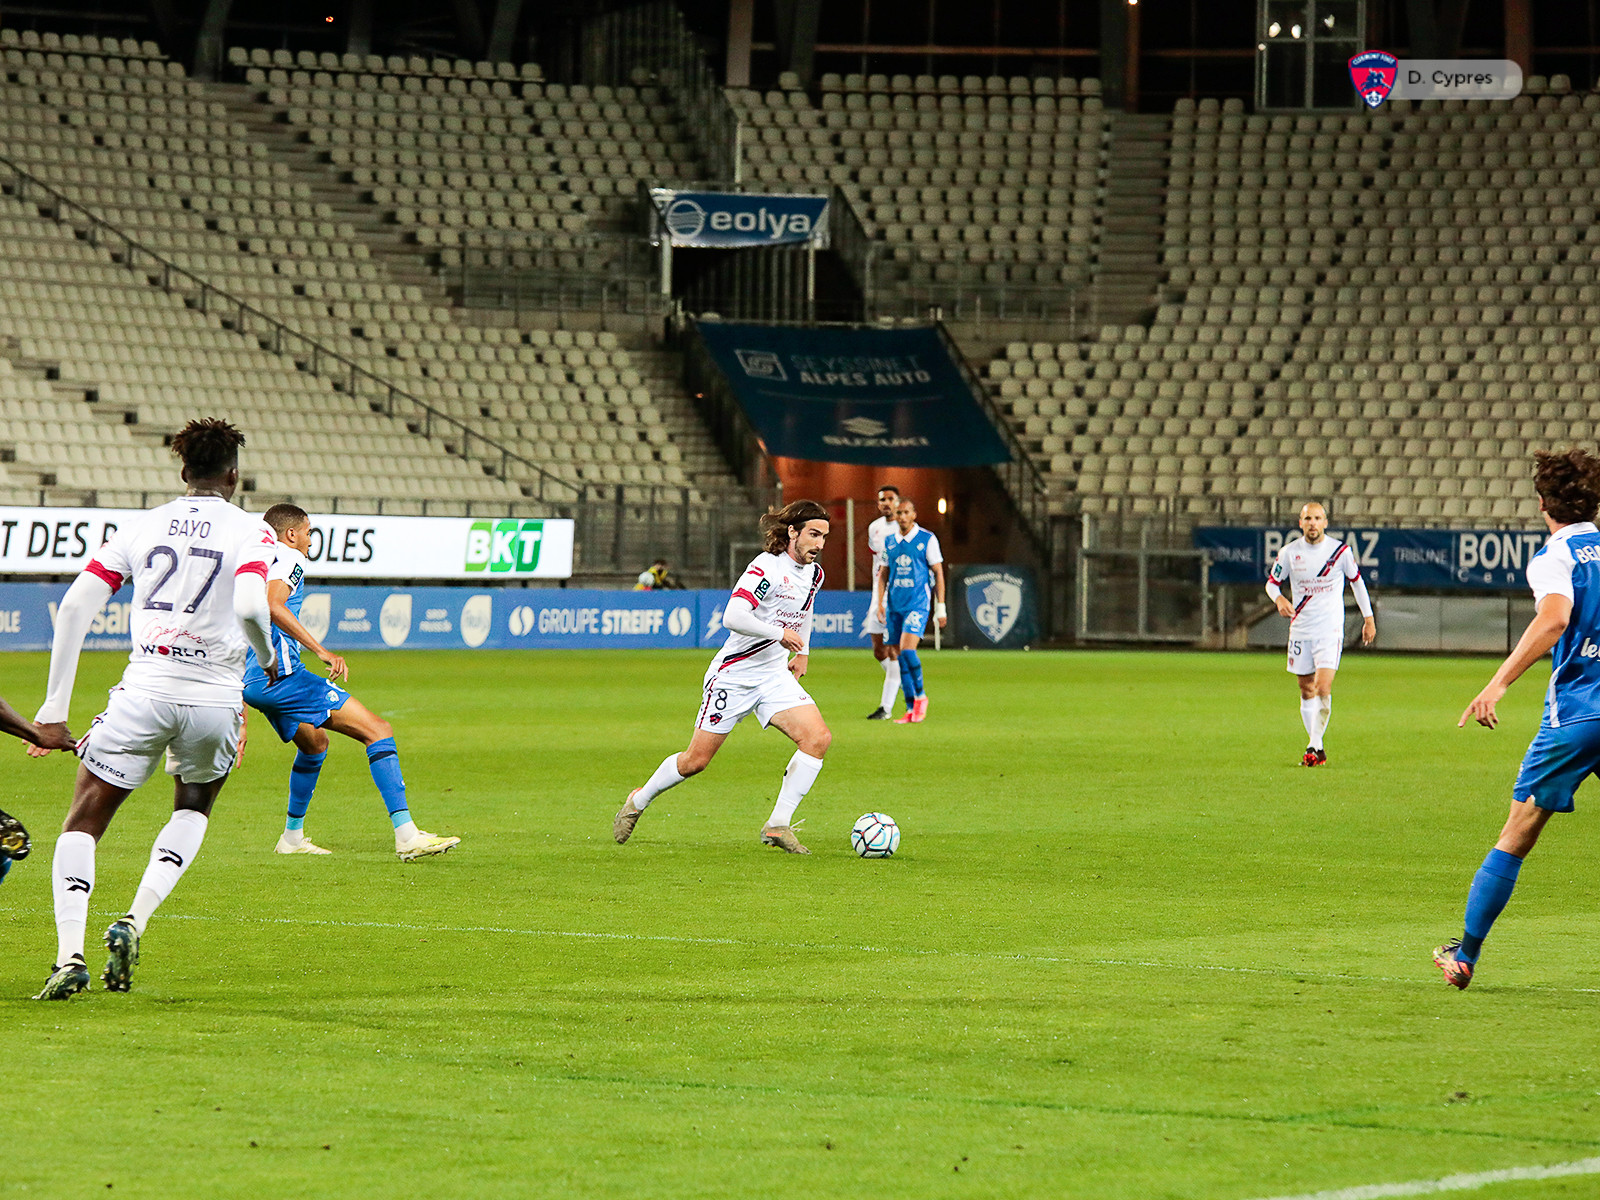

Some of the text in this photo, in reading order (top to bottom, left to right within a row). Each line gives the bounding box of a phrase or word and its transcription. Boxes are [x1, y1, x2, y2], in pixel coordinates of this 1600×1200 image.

[874, 369, 931, 386] AUTO
[168, 519, 211, 539] BAYO
[27, 521, 90, 558] DES
[308, 527, 375, 563] OLES
[465, 525, 543, 568] BKT
[1459, 533, 1549, 570] BONT
[143, 545, 223, 613] 27
[538, 607, 665, 636] GROUPE STREIFF
[812, 609, 854, 634] RICITÉ
[715, 689, 728, 711] 8
[96, 761, 126, 779] PATRICK
